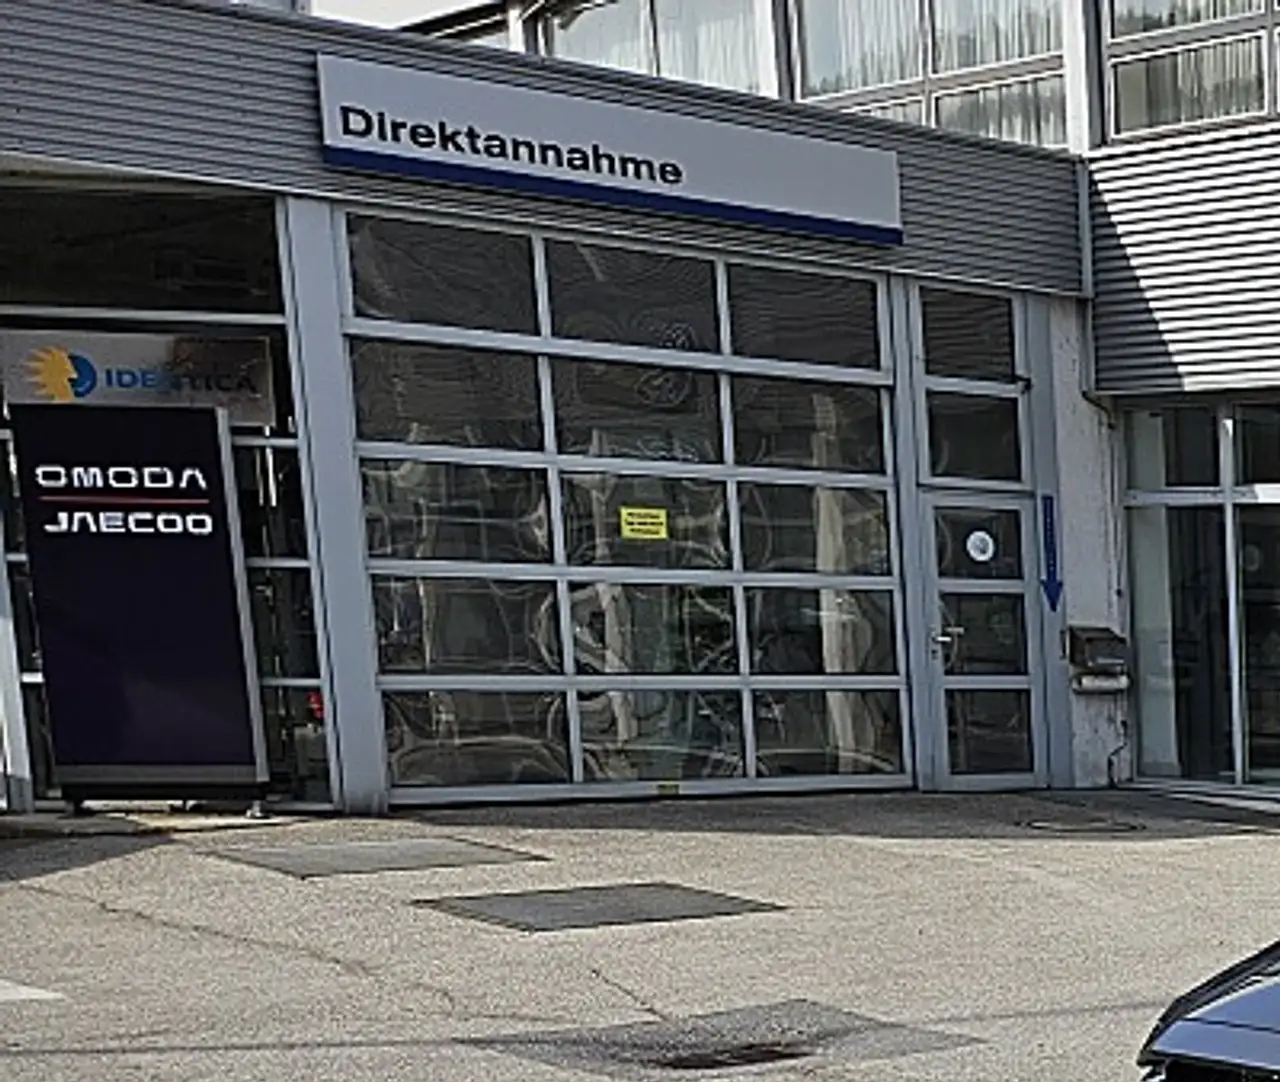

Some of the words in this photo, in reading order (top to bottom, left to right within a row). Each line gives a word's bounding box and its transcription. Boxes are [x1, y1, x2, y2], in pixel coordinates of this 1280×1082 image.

[339, 105, 684, 185] Direktannahme
[35, 465, 208, 490] OMODA
[44, 511, 214, 535] JAECOO
